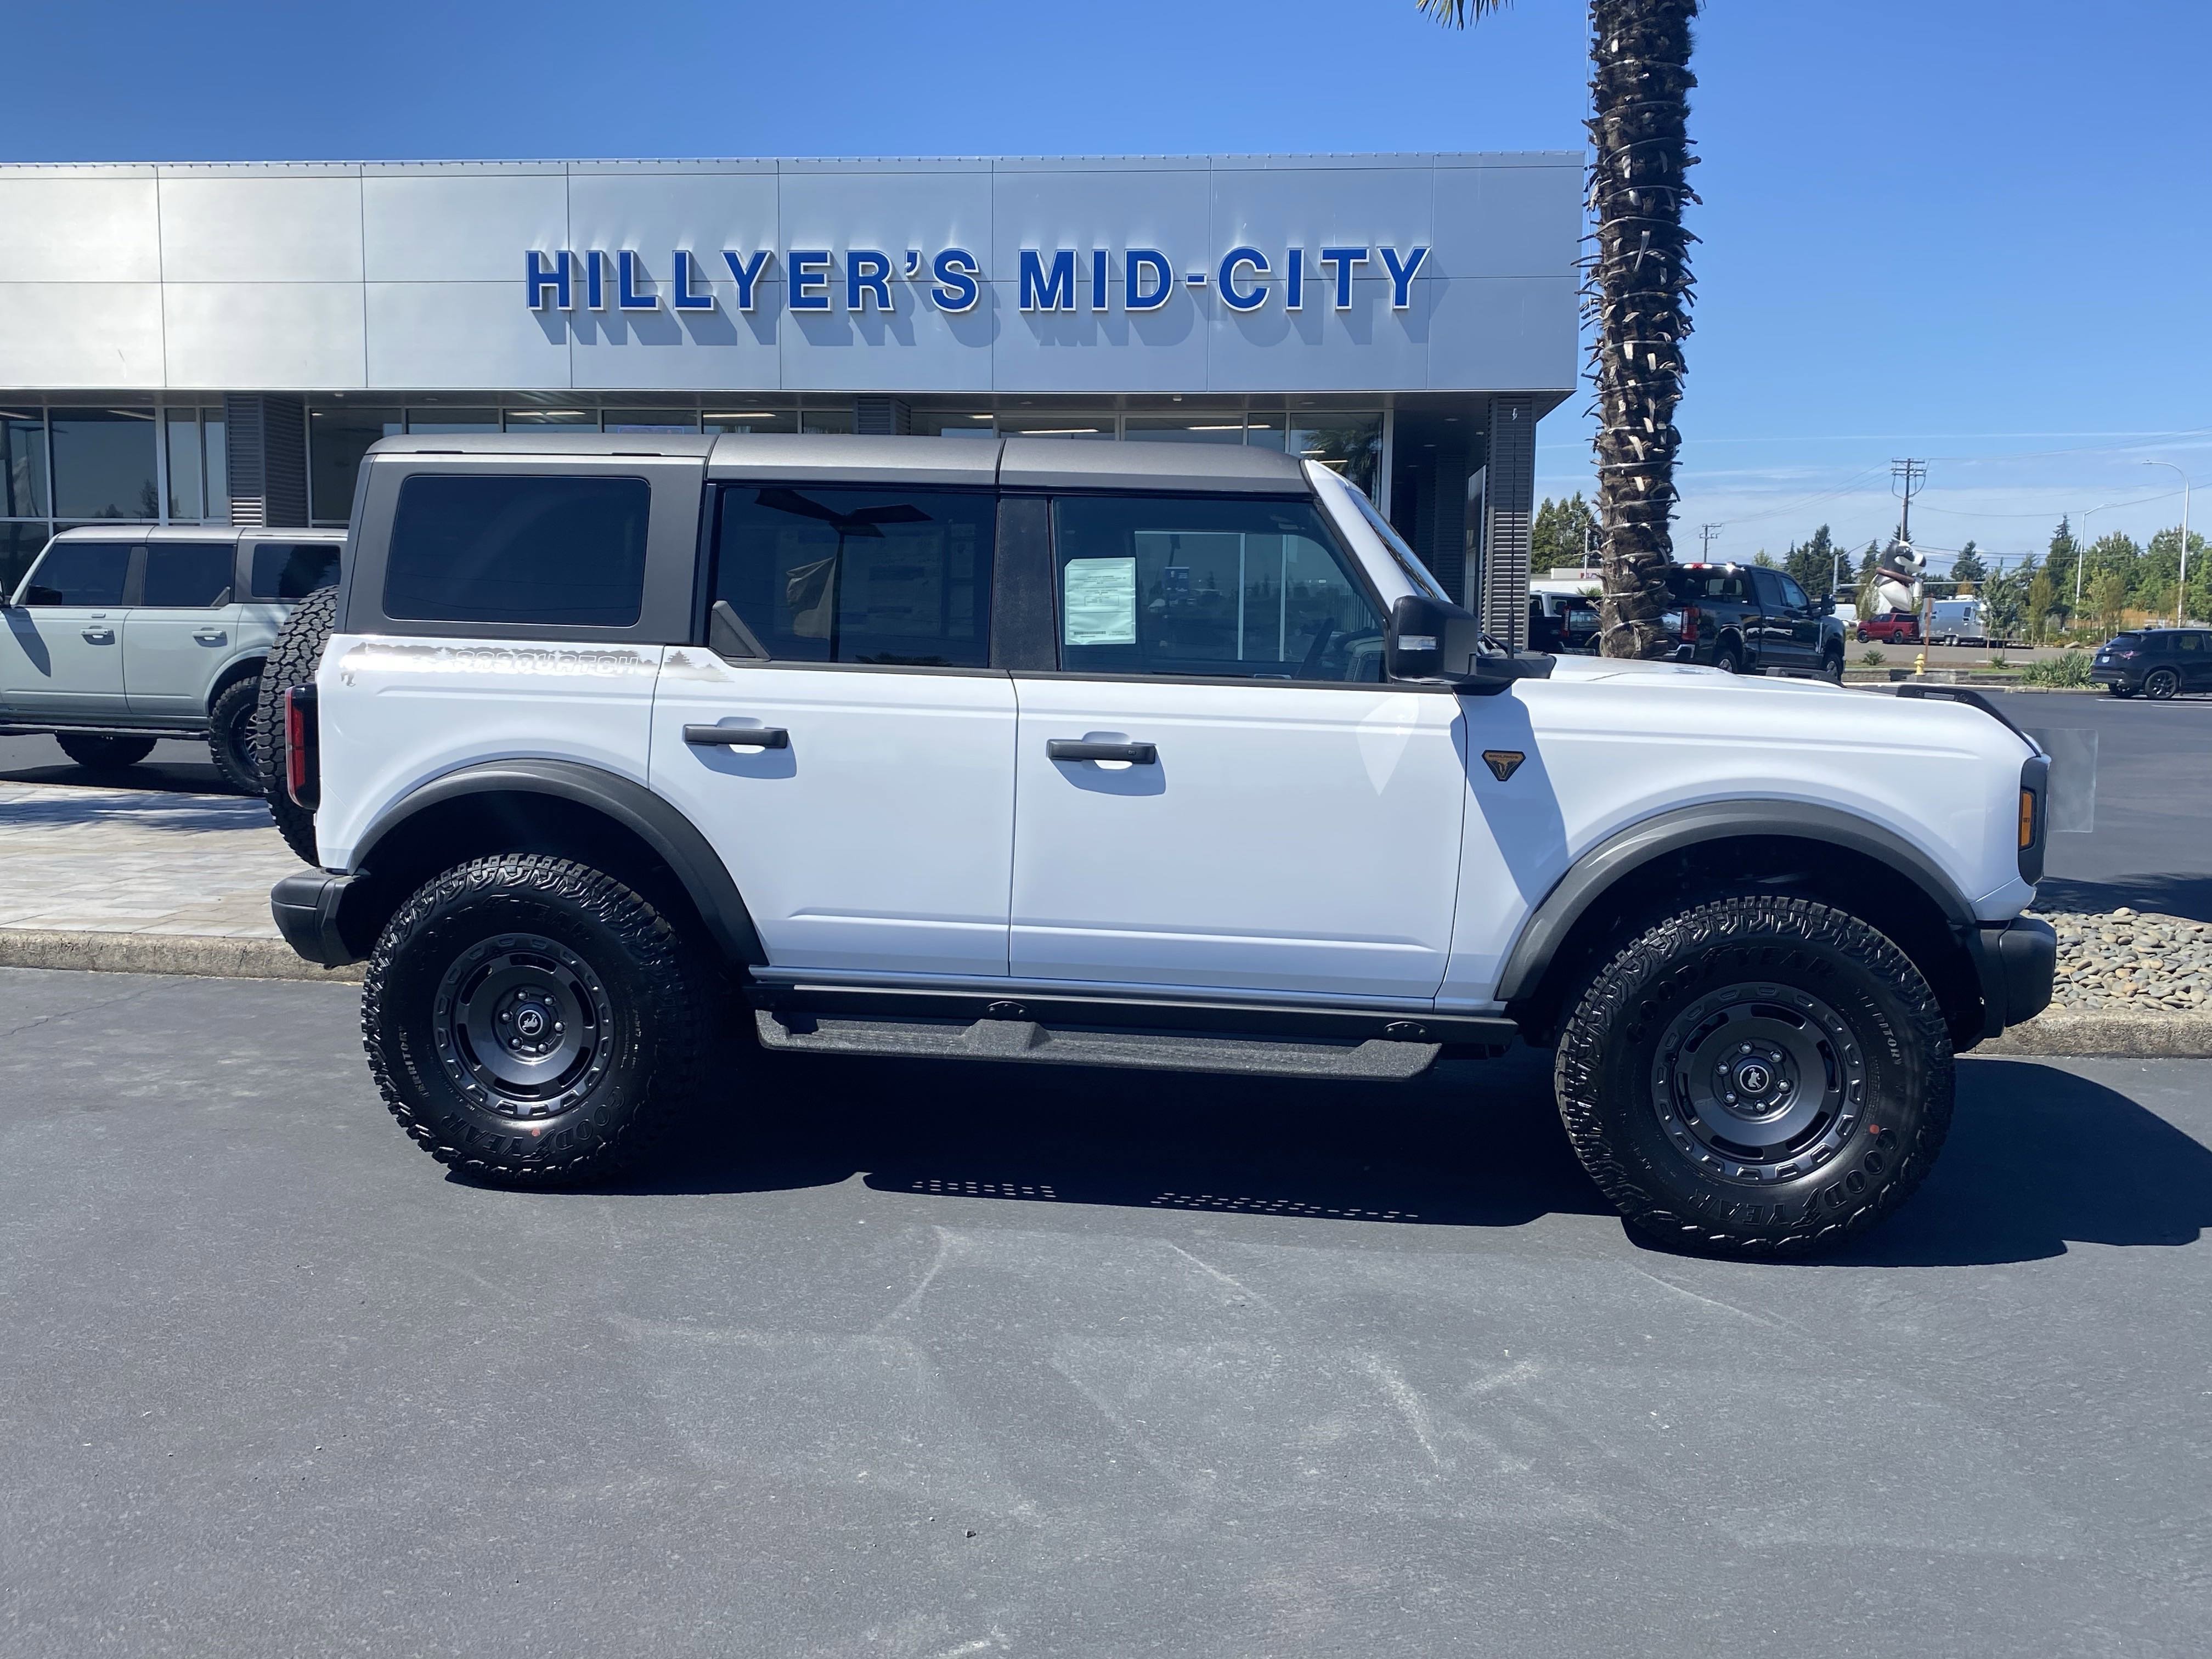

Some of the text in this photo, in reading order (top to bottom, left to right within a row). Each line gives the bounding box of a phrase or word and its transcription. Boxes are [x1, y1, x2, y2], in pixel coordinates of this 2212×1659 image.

[525, 246, 1432, 313] HILLYER'S MID-CITY
[456, 651, 639, 674] SASQUATCH
[441, 1086, 626, 1160] GOODYEAR
[1686, 1127, 1900, 1228] GOODYEAR
